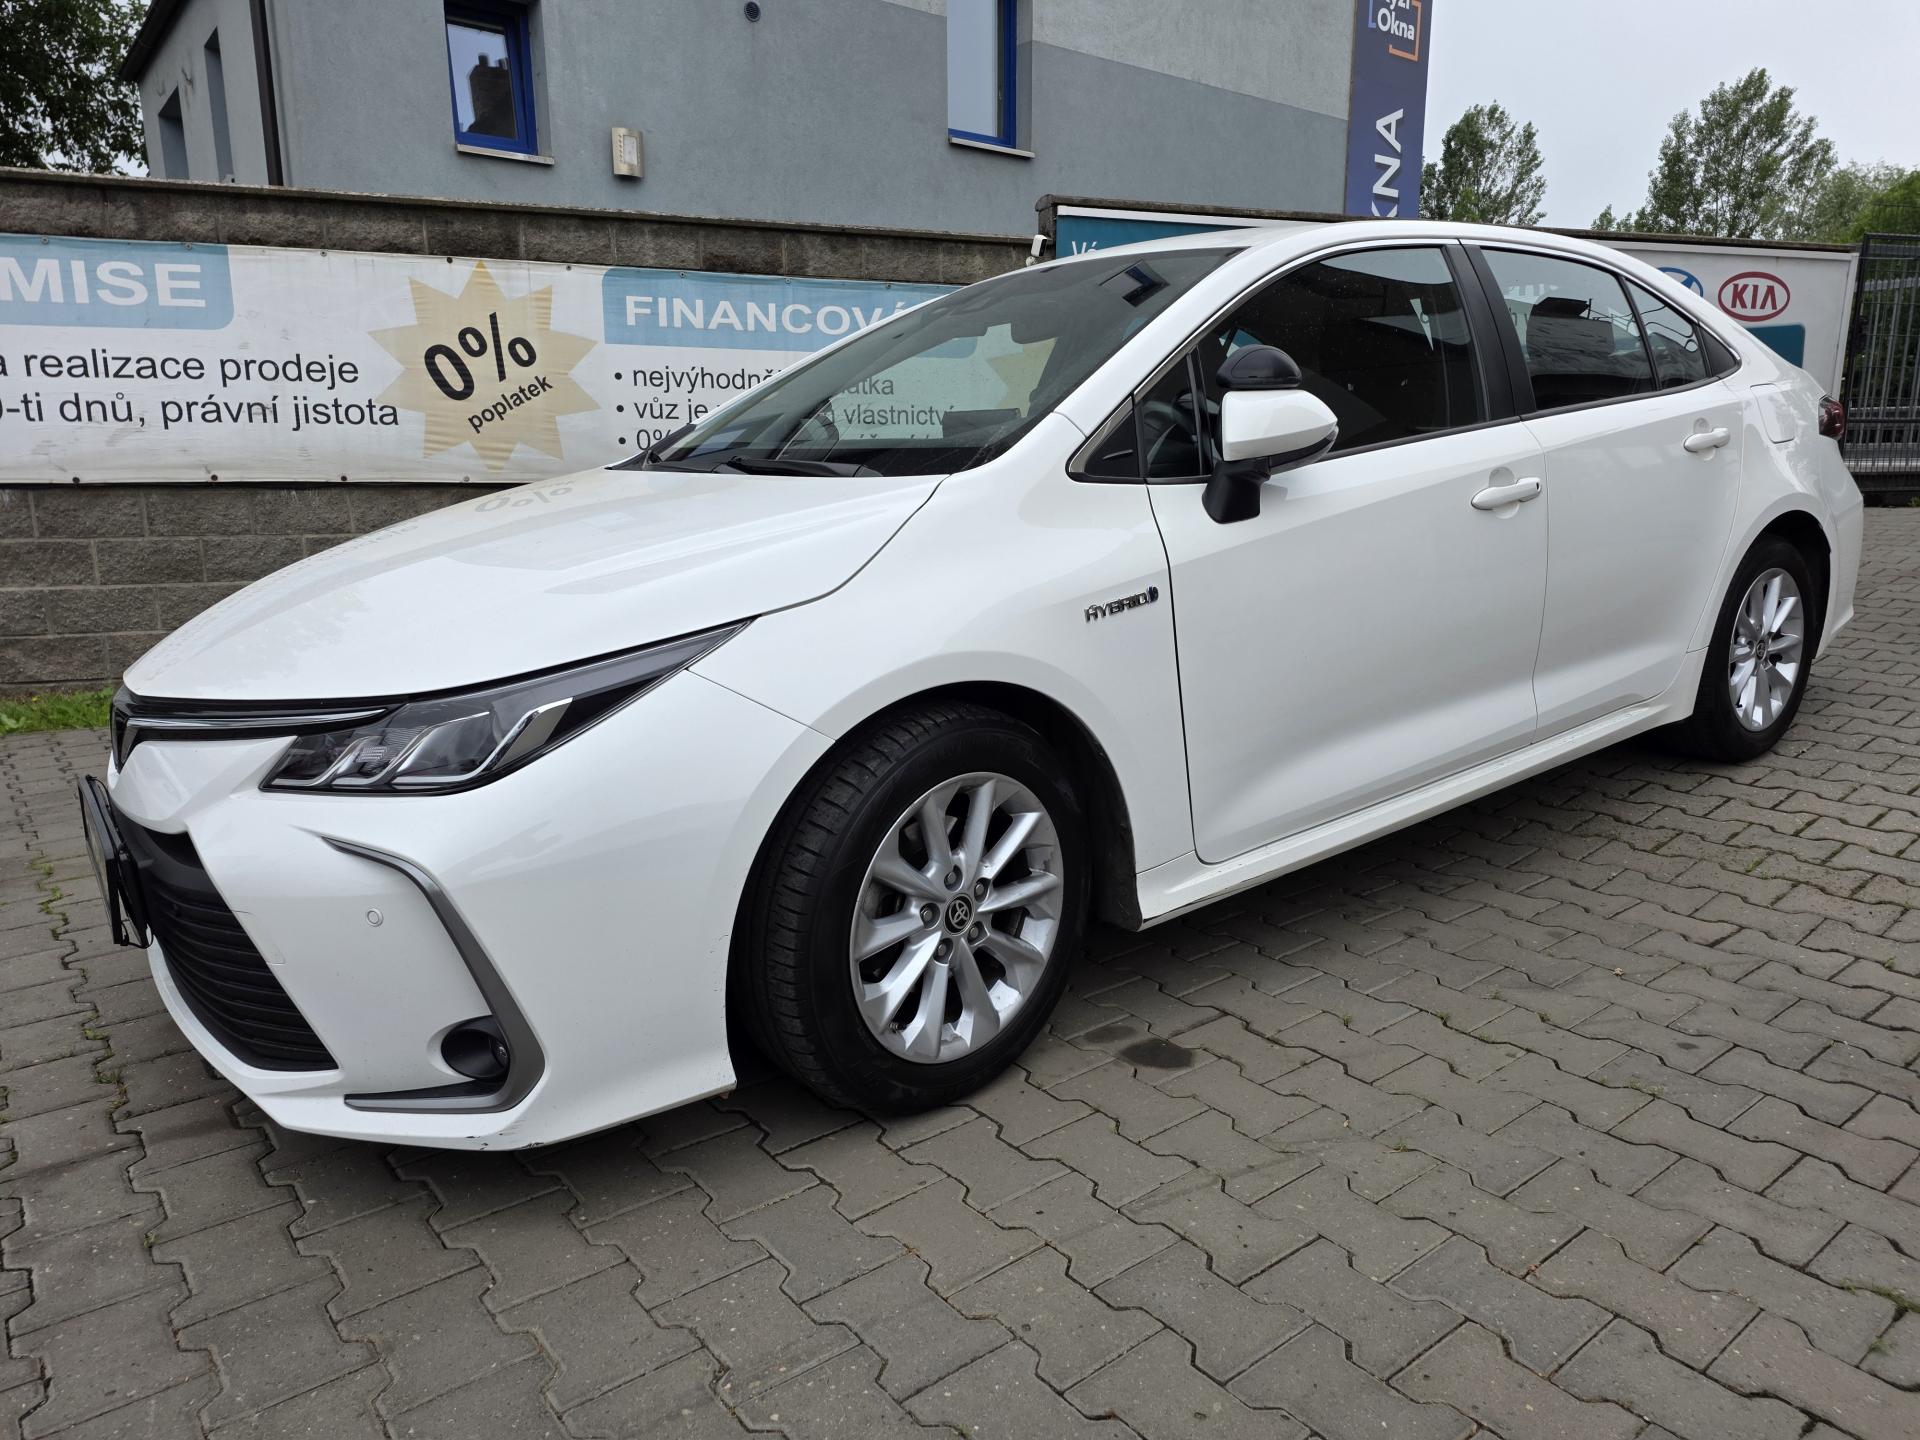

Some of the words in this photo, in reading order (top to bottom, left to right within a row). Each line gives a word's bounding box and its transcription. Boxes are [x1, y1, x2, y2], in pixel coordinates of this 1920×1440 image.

[1377, 7, 1415, 41] Okna
[0, 256, 206, 307] MISE
[1730, 282, 1777, 311] KIA
[24, 348, 205, 380] realizace
[220, 353, 359, 390] prodeje
[424, 311, 537, 401] 0%
[0, 391, 43, 422] -ti
[59, 391, 145, 428] dnů,
[161, 394, 279, 430] právní
[292, 396, 399, 432] jistota
[467, 375, 553, 434] poplatek
[633, 397, 679, 420] vůz
[843, 403, 954, 426] vlastnictv
[1083, 591, 1149, 623] HYBRID
